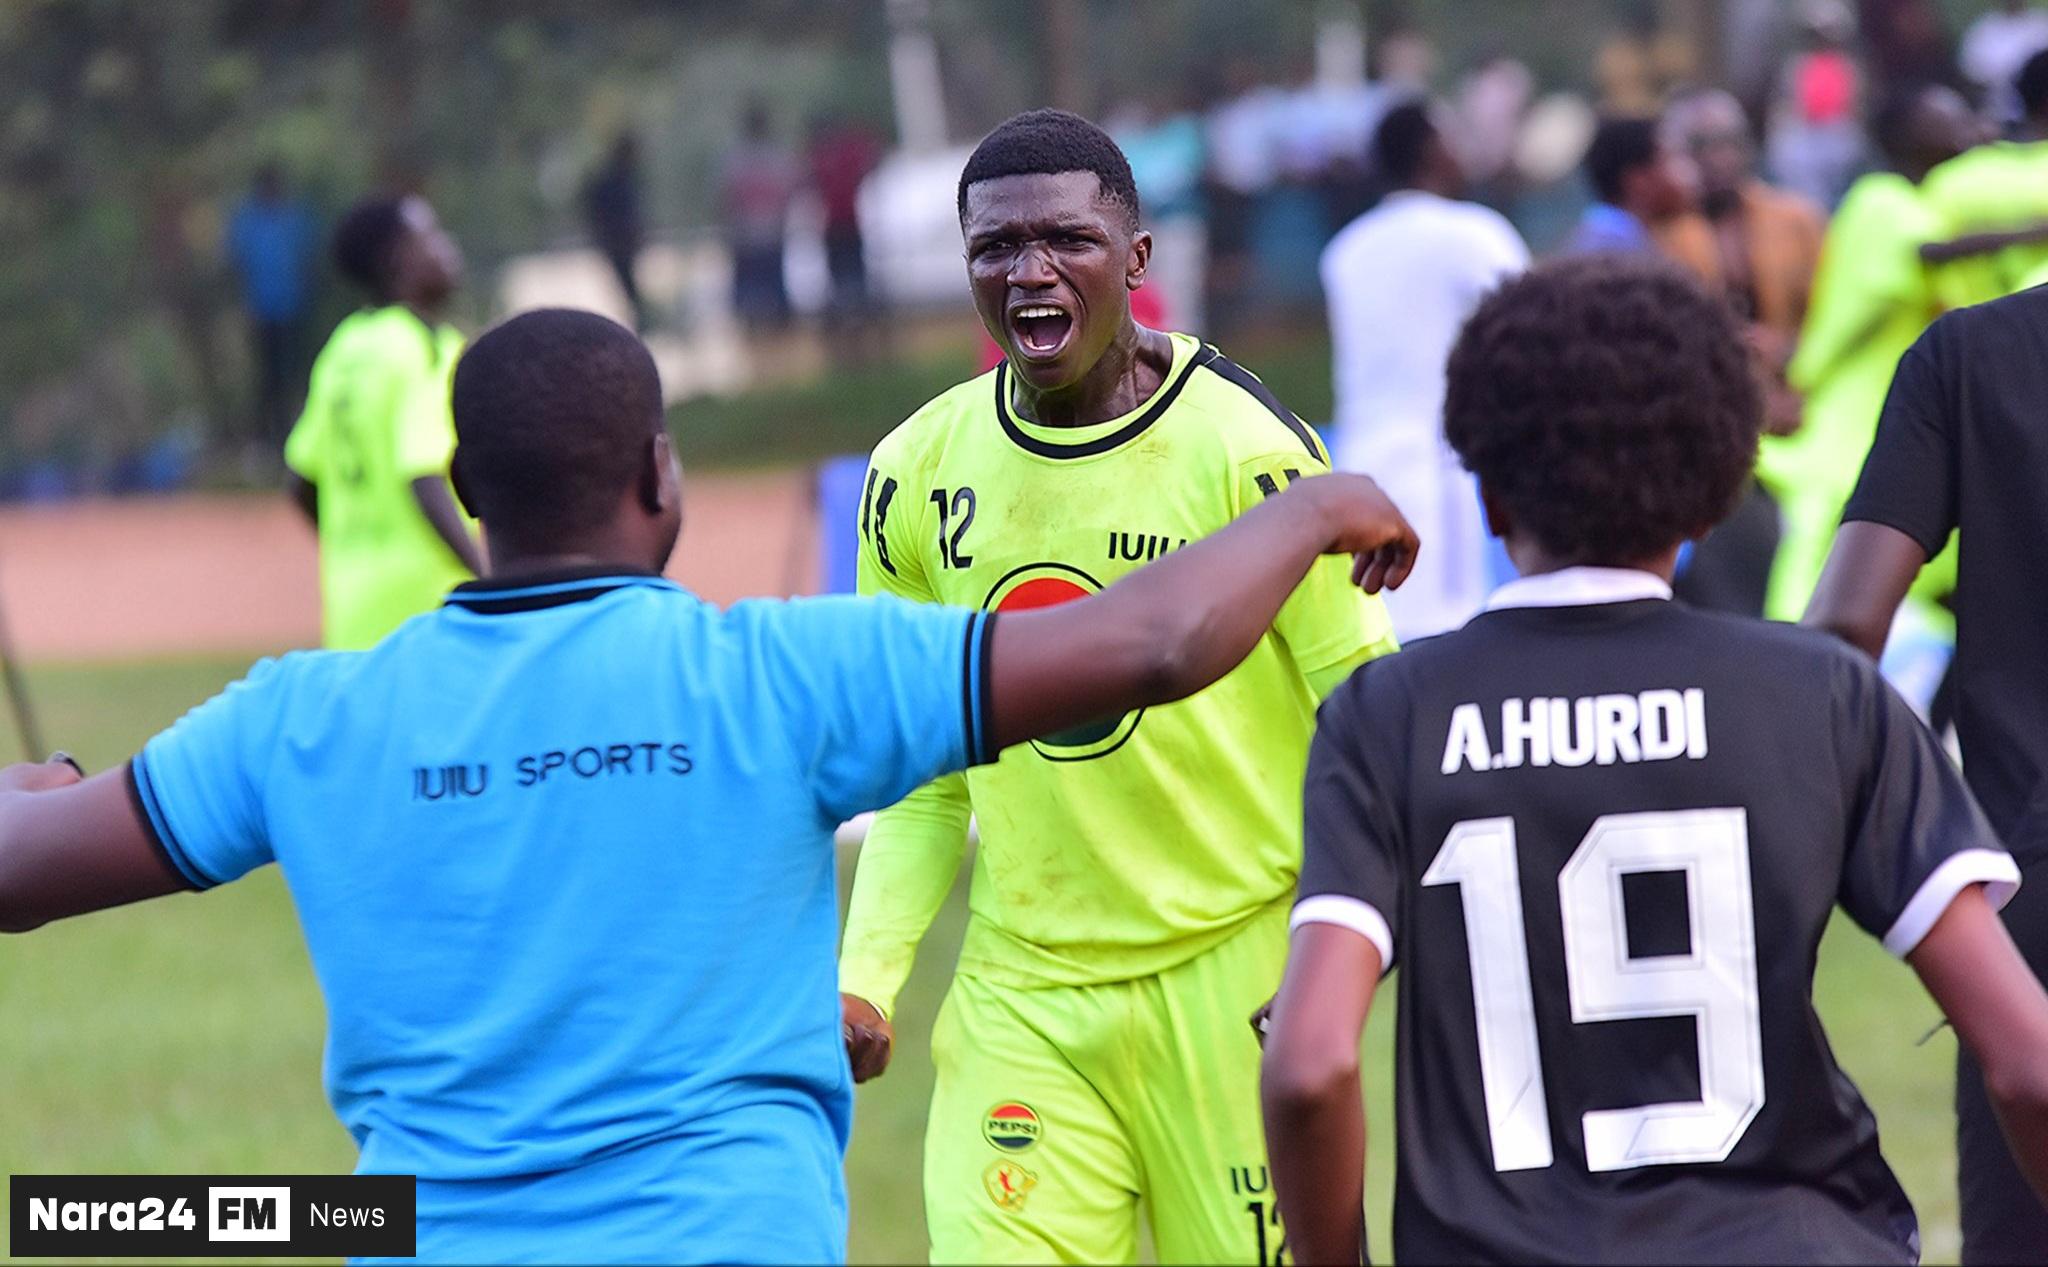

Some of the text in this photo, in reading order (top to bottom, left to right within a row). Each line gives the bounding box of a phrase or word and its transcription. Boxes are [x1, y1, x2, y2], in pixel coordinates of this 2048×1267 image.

[930, 486, 976, 570] 12
[1108, 531, 1187, 561] IUI
[1441, 687, 1709, 775] A.HURDI
[515, 743, 693, 787] SPORTS
[1420, 806, 1766, 1173] 19
[988, 1120, 1038, 1136] PEPSI
